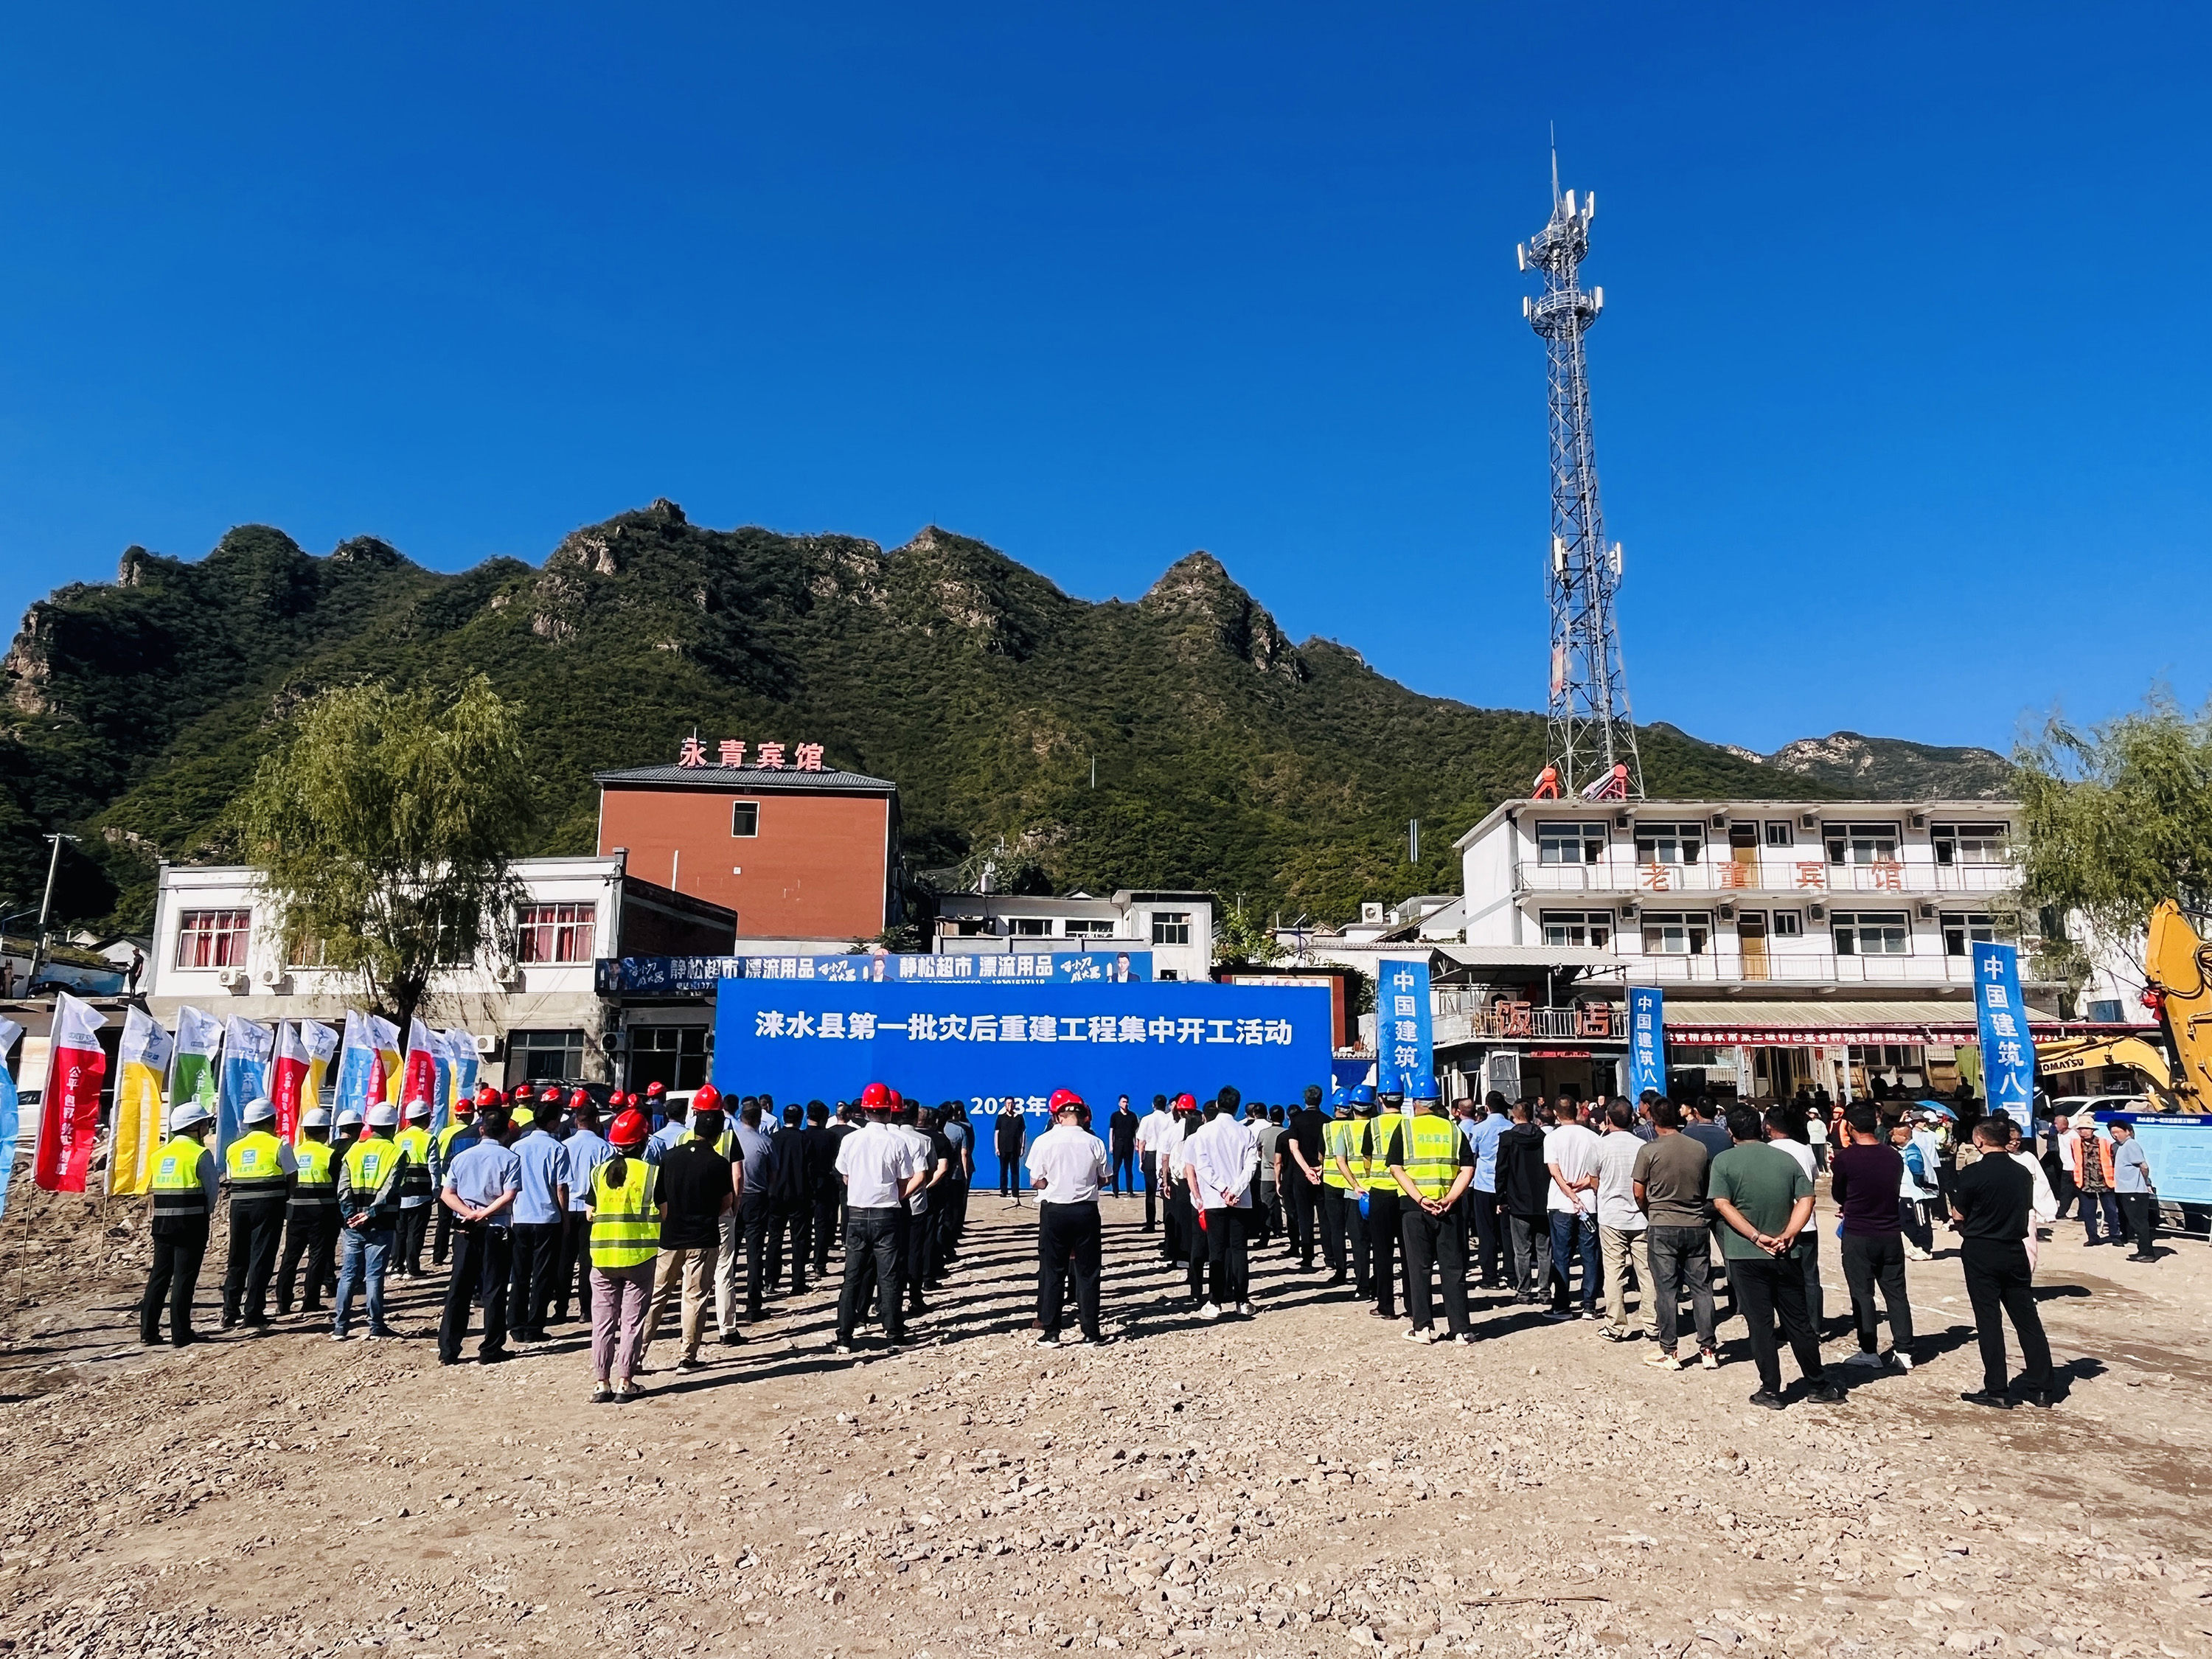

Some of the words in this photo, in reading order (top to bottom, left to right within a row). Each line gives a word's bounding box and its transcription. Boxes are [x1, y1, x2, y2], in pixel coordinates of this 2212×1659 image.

[678, 737, 824, 771] 永青宾馆
[1641, 860, 1905, 891] 老董宾馆
[669, 958, 739, 979] 静松超市
[745, 958, 815, 979] 漂流用品
[899, 956, 973, 978] 静松超市
[978, 955, 1054, 978] 漂流用品
[754, 1009, 1293, 1046] 涞水县第一批灾后重建工程集中开工活动
[1495, 999, 1610, 1037] 饭店
[1983, 954, 2031, 1127] 中国建筑八局
[2042, 1058, 2084, 1072] OMATSU
